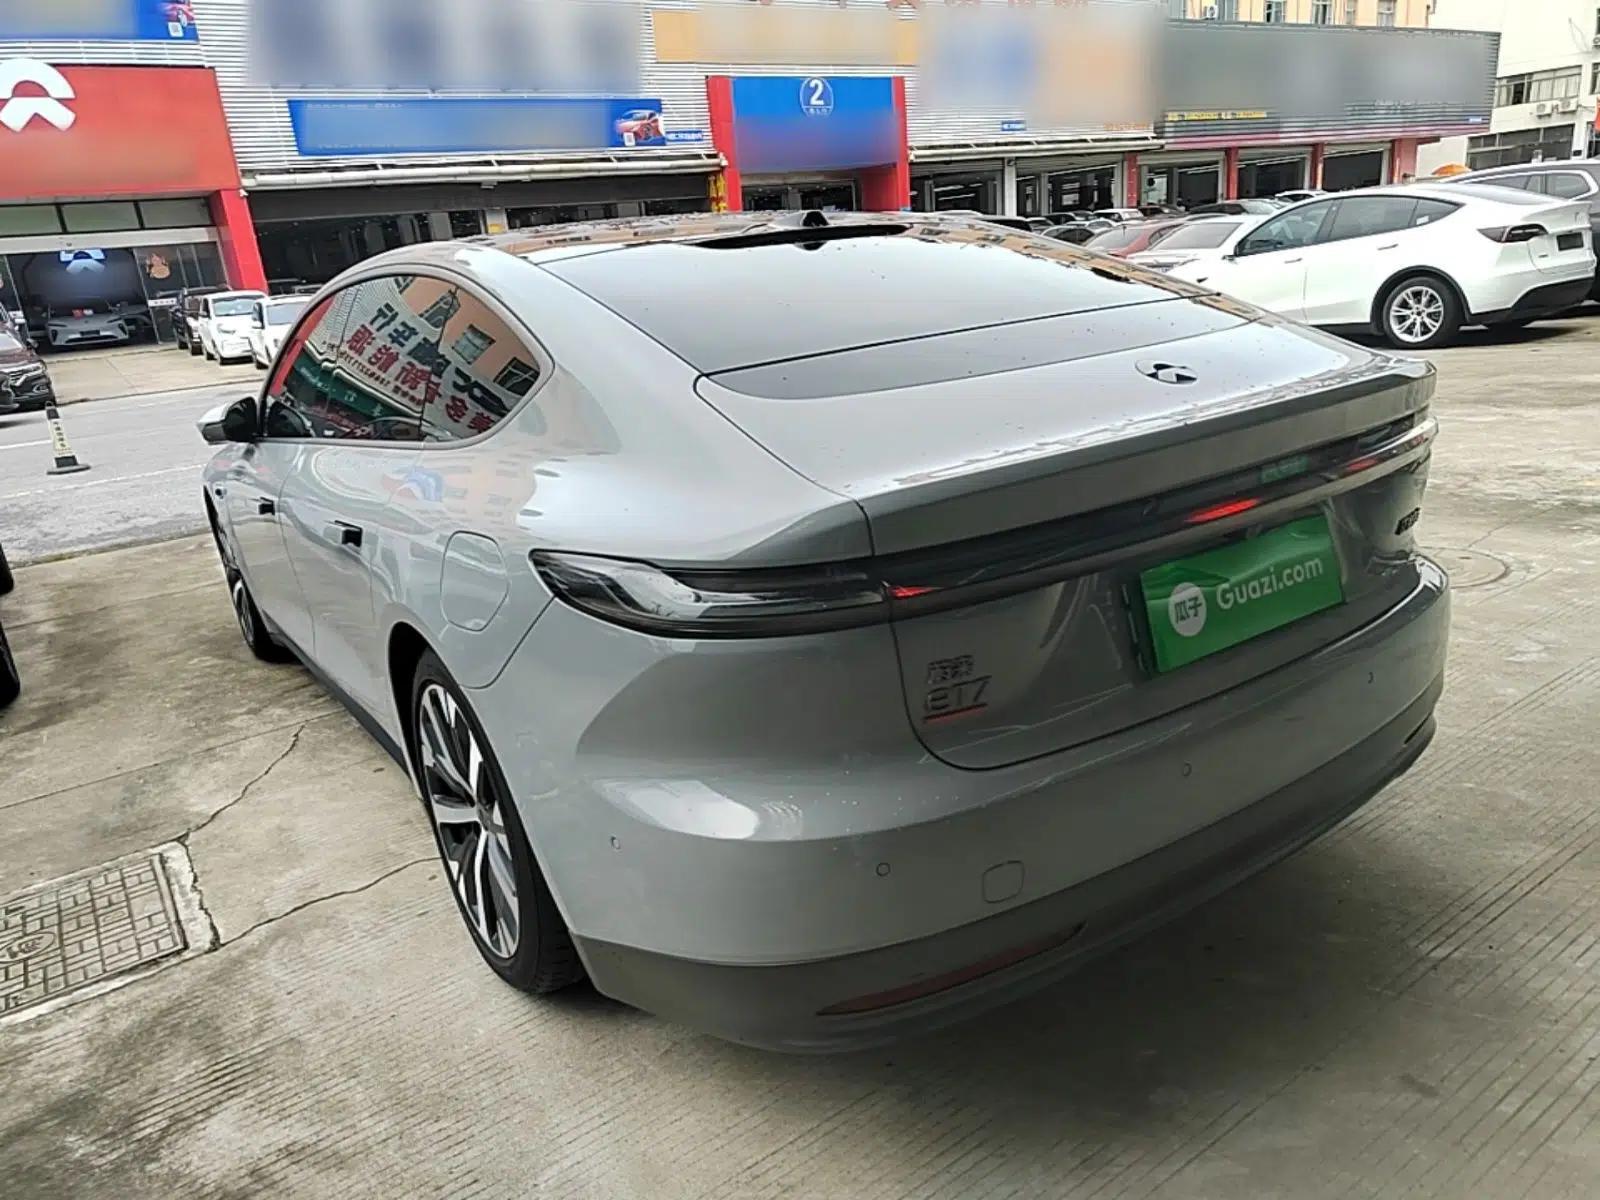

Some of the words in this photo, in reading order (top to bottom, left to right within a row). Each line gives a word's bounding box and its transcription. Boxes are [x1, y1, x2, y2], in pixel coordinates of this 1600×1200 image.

[809, 79, 825, 106] 2
[1174, 596, 1203, 624] 瓜子
[1216, 557, 1324, 610] Guazi.com
